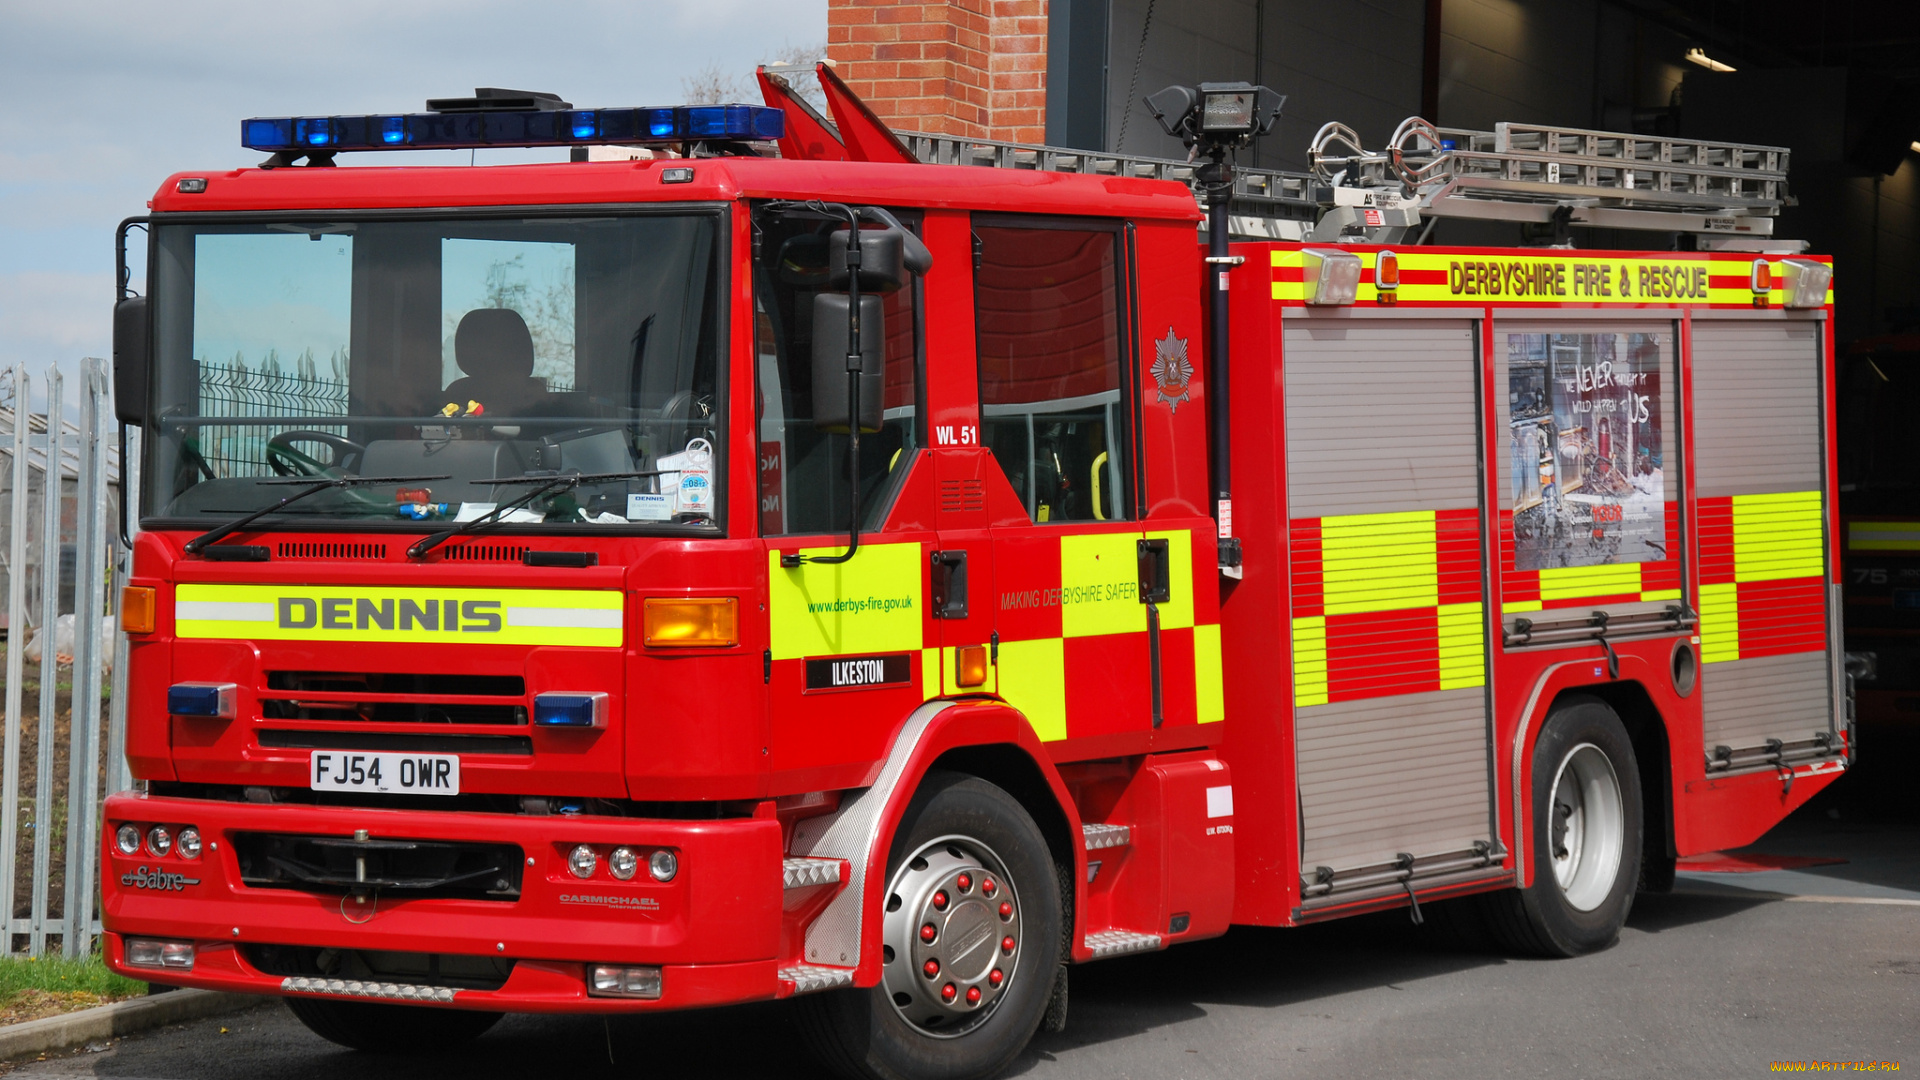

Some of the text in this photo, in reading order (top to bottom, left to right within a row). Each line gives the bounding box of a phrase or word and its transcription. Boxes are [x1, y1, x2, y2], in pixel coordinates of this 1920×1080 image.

[1364, 193, 1373, 205] AS
[1450, 261, 1707, 298] DERBYSHIRE FIRE & RESCUE
[1575, 361, 1614, 393] NEVER
[1593, 399, 1617, 413] HAPPEN
[1627, 390, 1650, 424] US
[936, 425, 976, 445] WL 51
[688, 479, 698, 488] 08
[1592, 504, 1622, 523] YOUR
[1852, 568, 1888, 584] 75
[808, 595, 912, 615] www.derbys-fire.gov.uk
[1001, 582, 1137, 611] MAKING DERBYSHIRE SAFER
[278, 597, 502, 633] DENNIS
[832, 659, 884, 686] ILKESTON
[316, 754, 451, 788] FJ54 OWR
[136, 865, 185, 891] Sabre
[559, 894, 660, 905] CARMICHAEL
